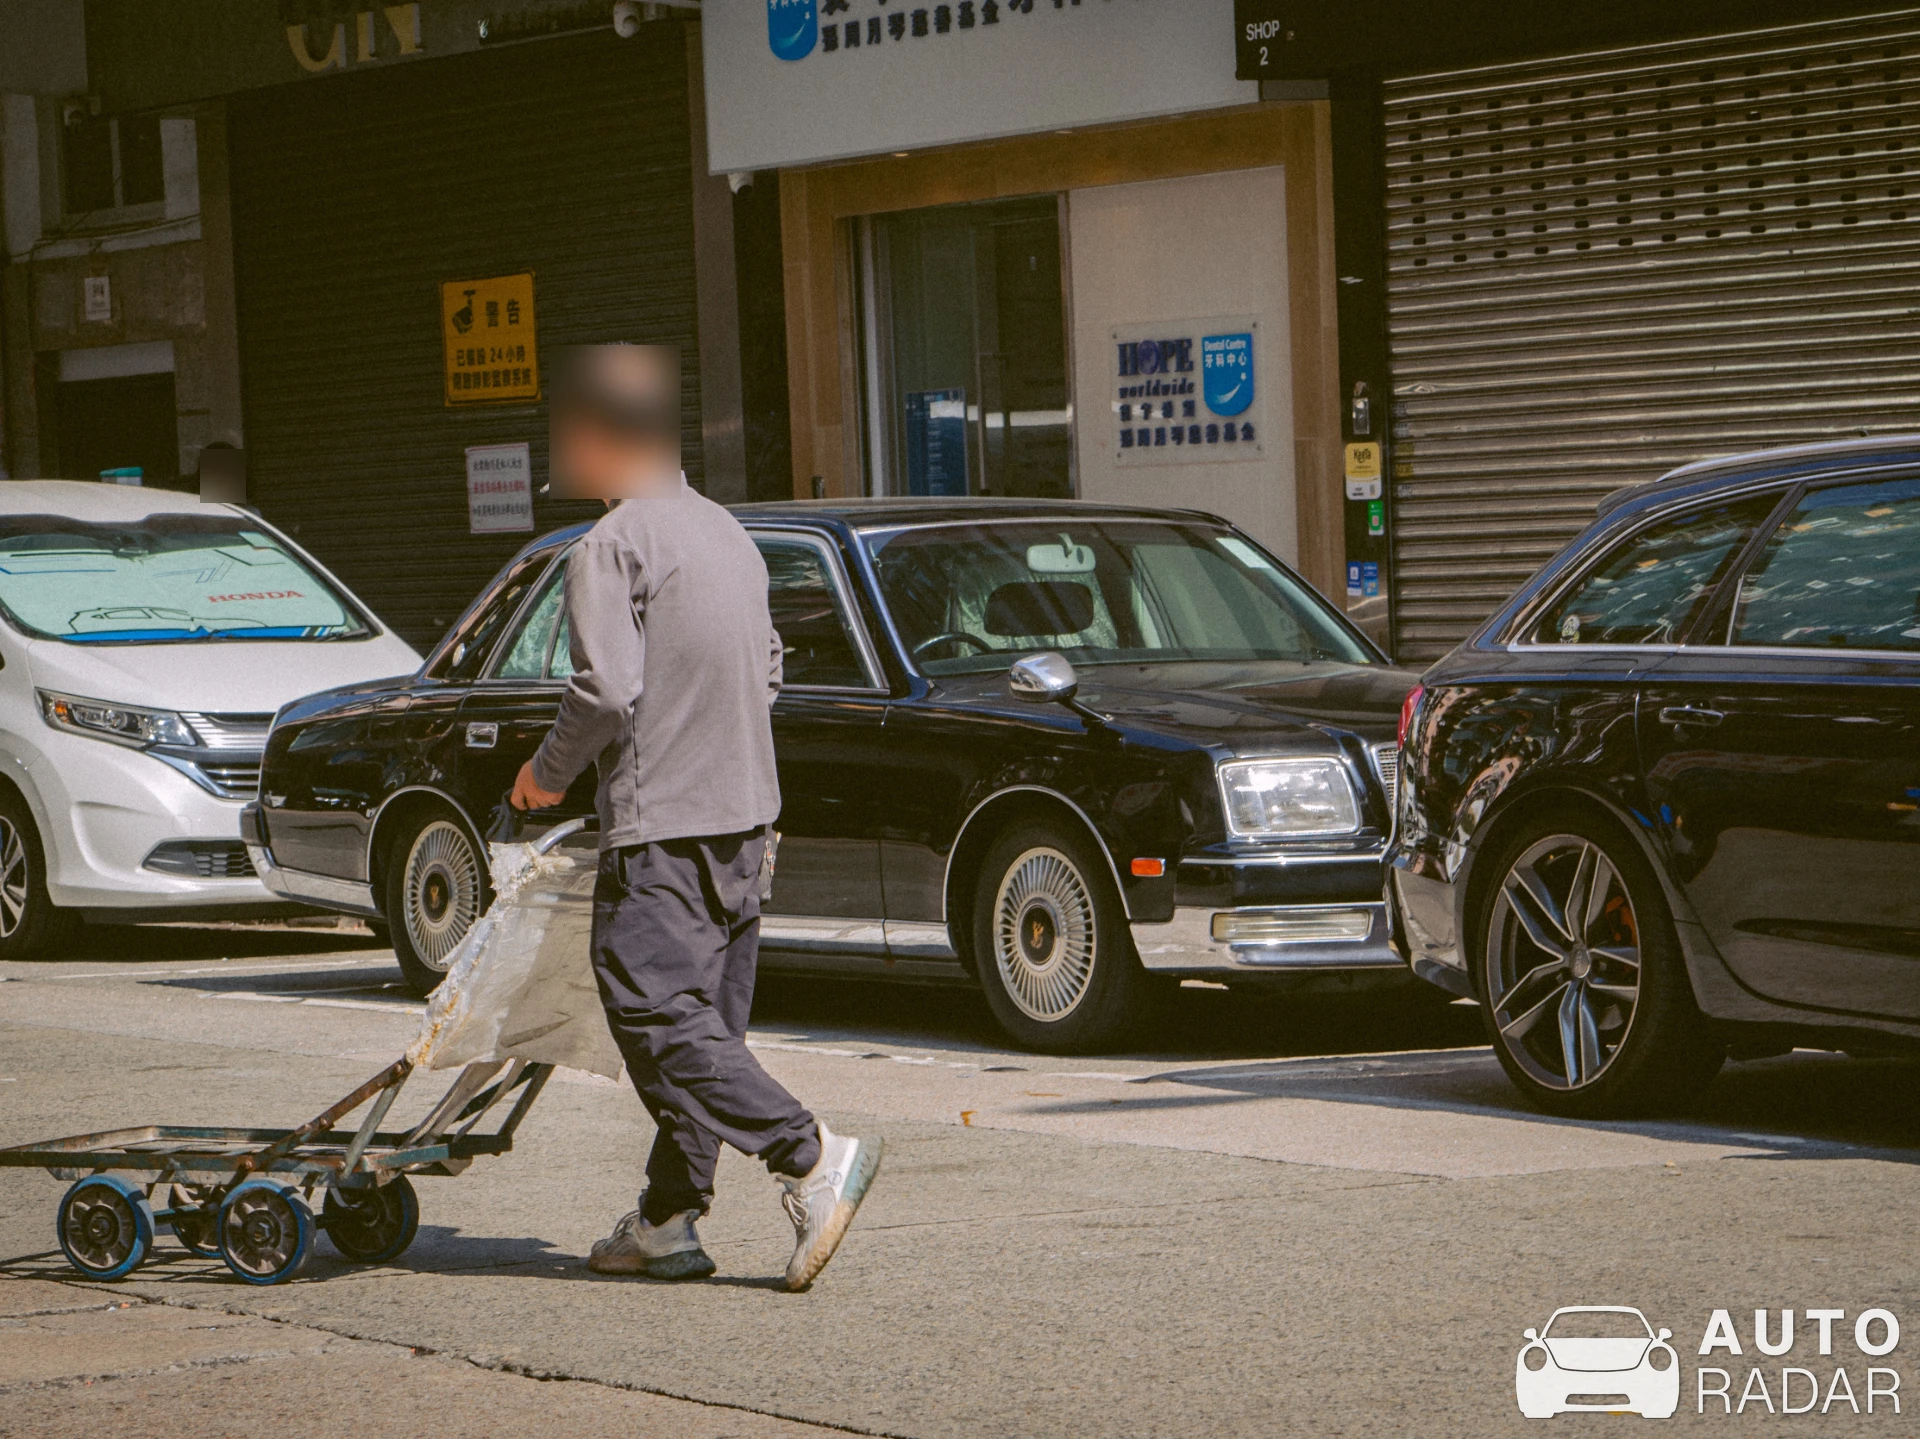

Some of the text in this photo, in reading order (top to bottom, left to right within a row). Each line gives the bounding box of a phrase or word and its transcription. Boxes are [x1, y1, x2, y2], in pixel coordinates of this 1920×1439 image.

[1246, 19, 1280, 41] SHOP
[1259, 46, 1269, 66] 2
[486, 299, 520, 328] 警告
[1204, 339, 1246, 352] Dental Centre
[1117, 339, 1194, 376] HOPE
[1205, 352, 1247, 368] 牙科中心
[1119, 377, 1194, 399] worldwide
[208, 590, 304, 602] HONDA
